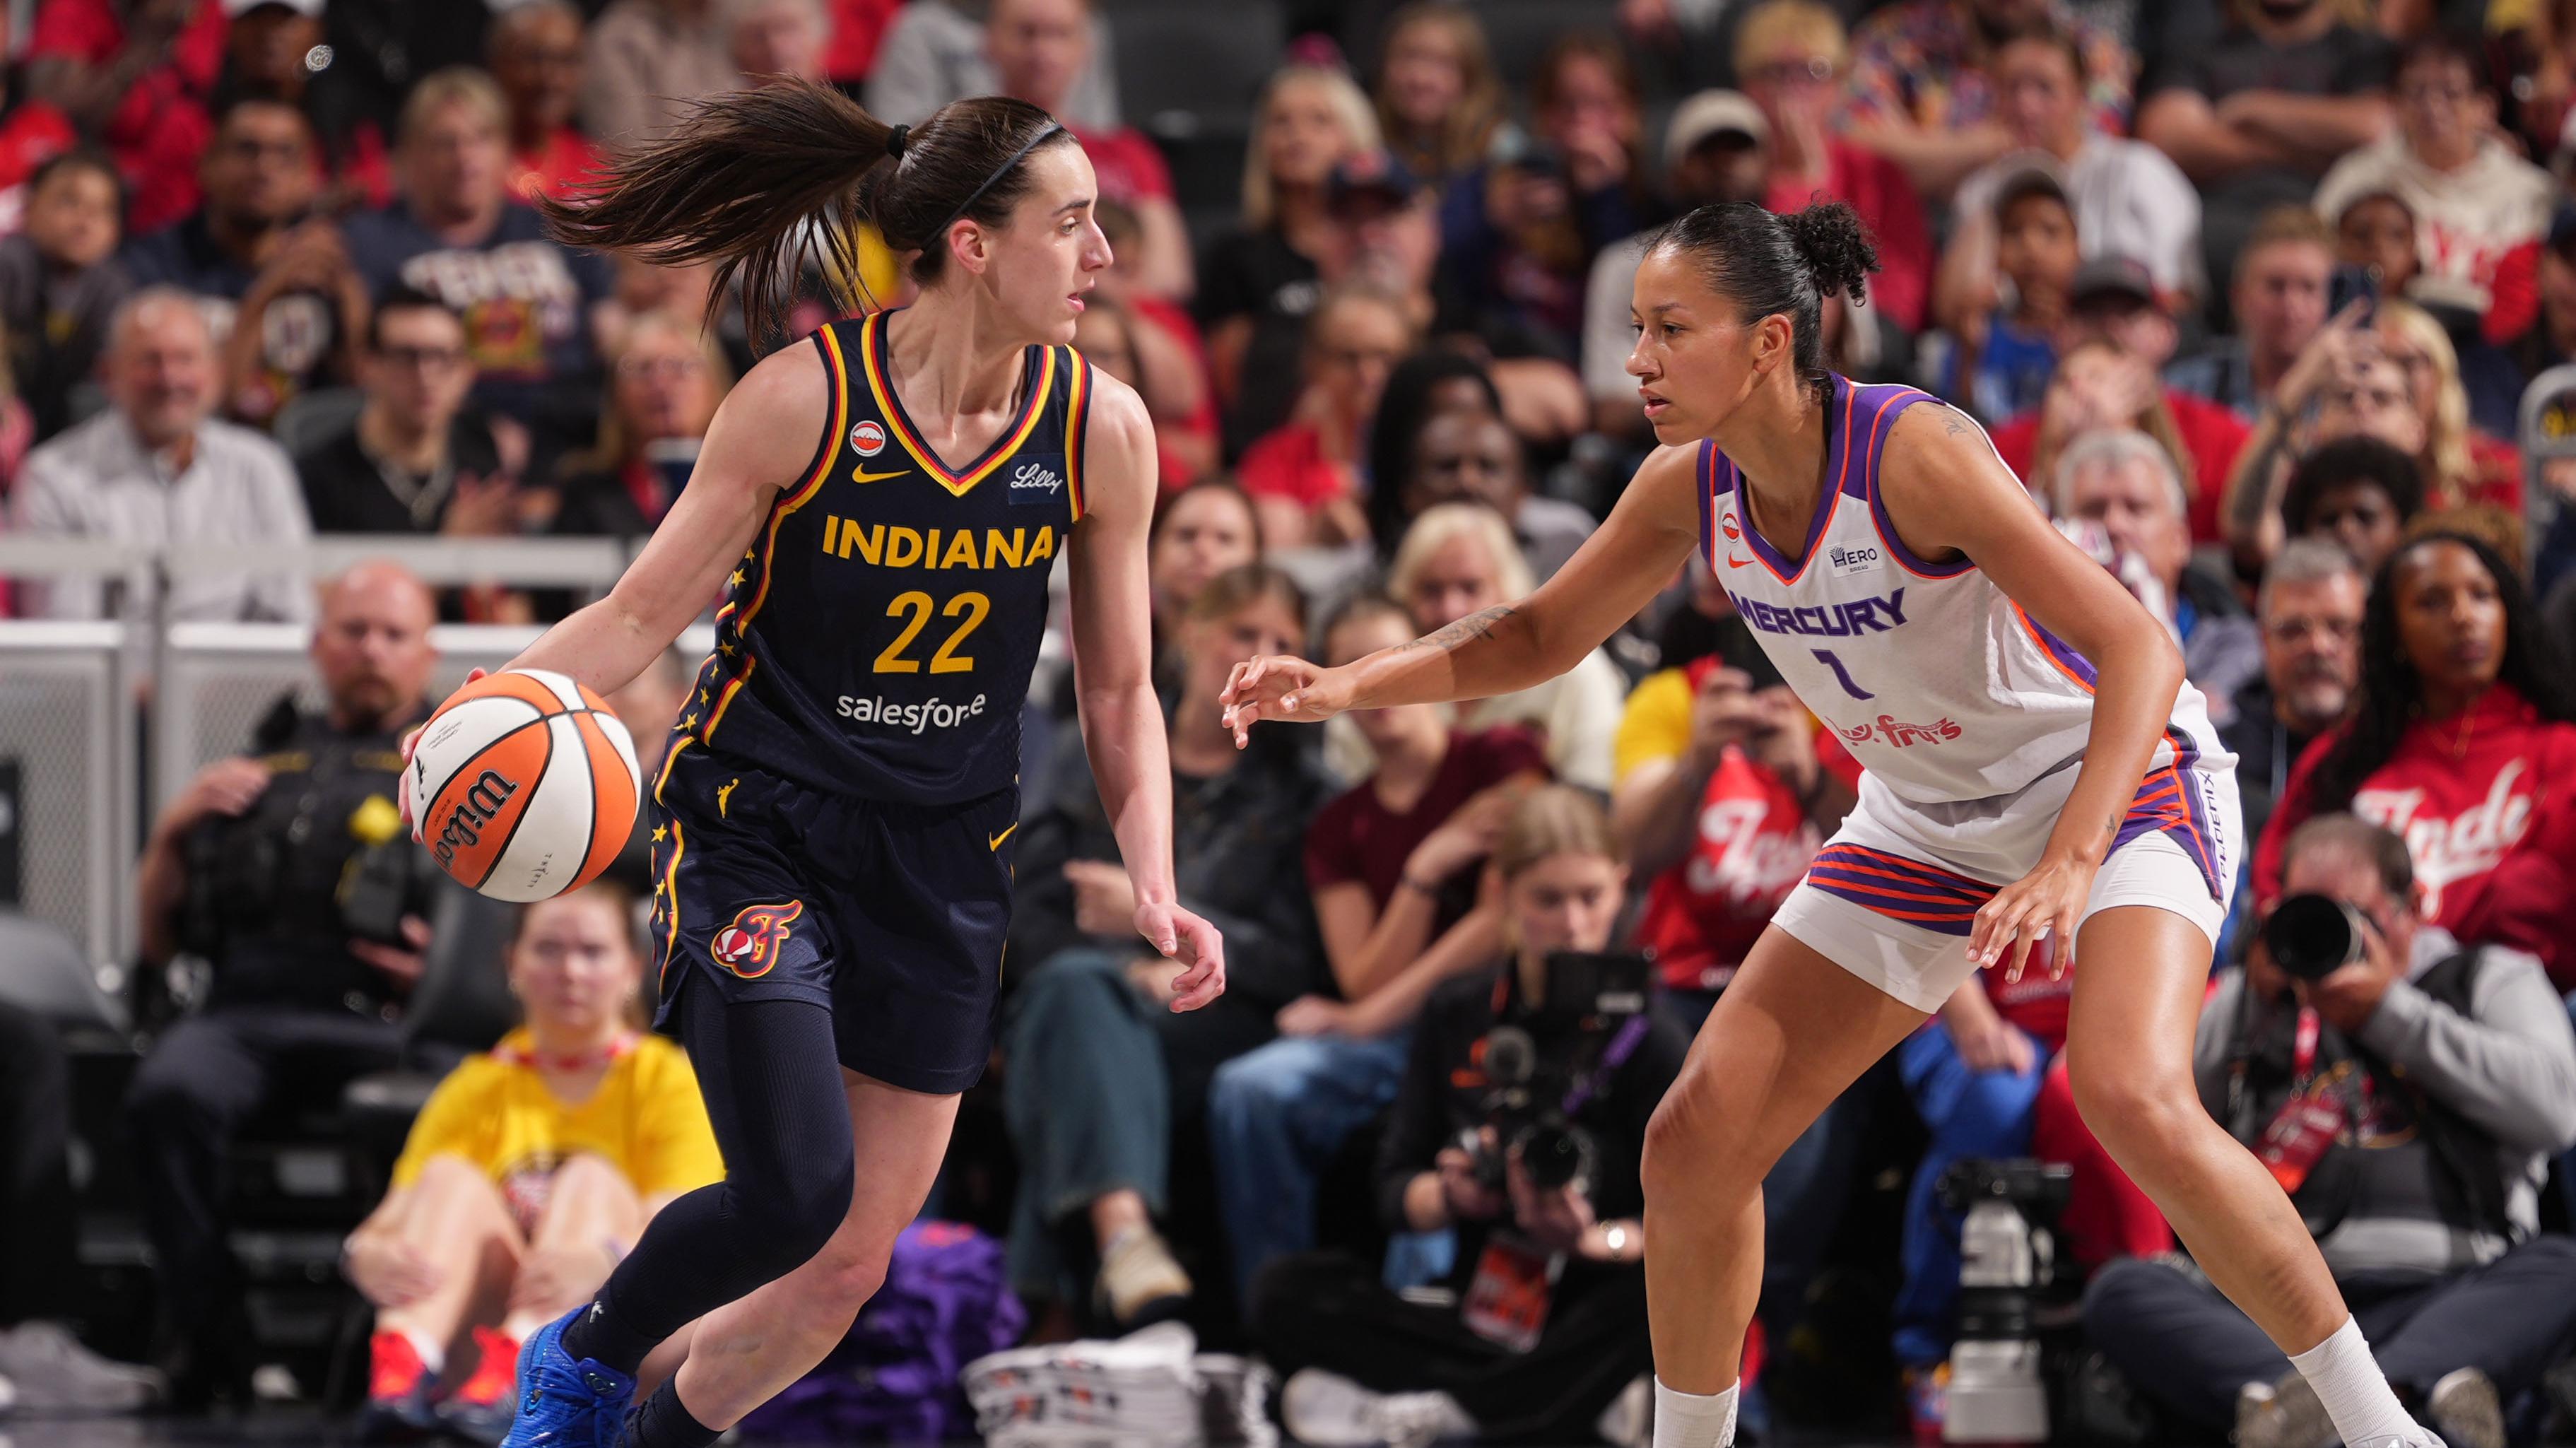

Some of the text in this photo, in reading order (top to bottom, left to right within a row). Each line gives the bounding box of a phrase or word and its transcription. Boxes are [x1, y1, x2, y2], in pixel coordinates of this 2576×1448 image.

[1010, 463, 1063, 495] Lilly
[822, 514, 1053, 570] INDIANA
[1829, 546, 1877, 567] HERO
[873, 591, 990, 674] 22
[1729, 587, 1907, 637] MERCURY
[1810, 648, 1875, 700] 1
[836, 693, 986, 735] salesfore
[2199, 770, 2227, 880] PHOENIX
